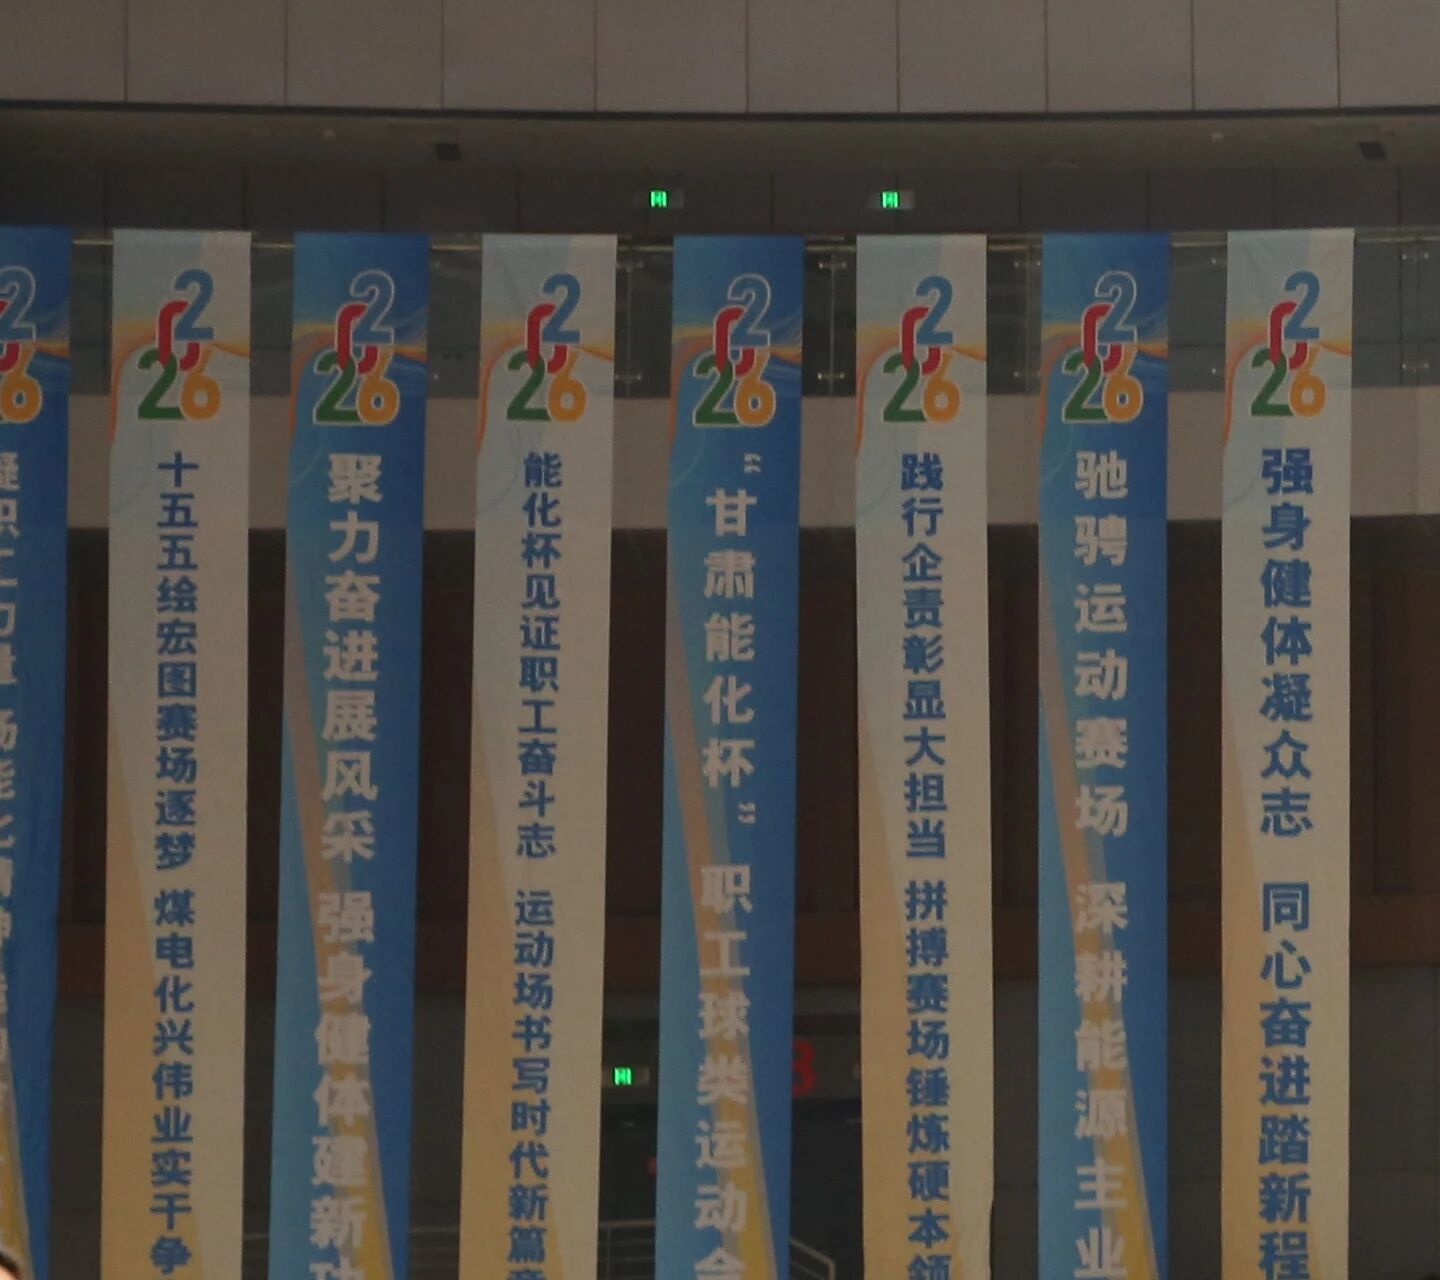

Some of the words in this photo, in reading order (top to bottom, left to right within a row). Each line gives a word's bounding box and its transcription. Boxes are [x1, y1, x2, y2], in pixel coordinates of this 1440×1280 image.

[154, 451, 199, 871] 十五五绘宏图赛场逐梦
[320, 452, 384, 864] 聚力奋进展风采
[515, 451, 563, 860] 能化杯见证职工奋斗志
[899, 452, 948, 860] 践行企责彰显大担当
[1074, 450, 1129, 837] 驰骋运动赛场
[1259, 447, 1314, 838] 强身健体凝众志
[1073, 882, 1129, 1280] 深耕能源主业
